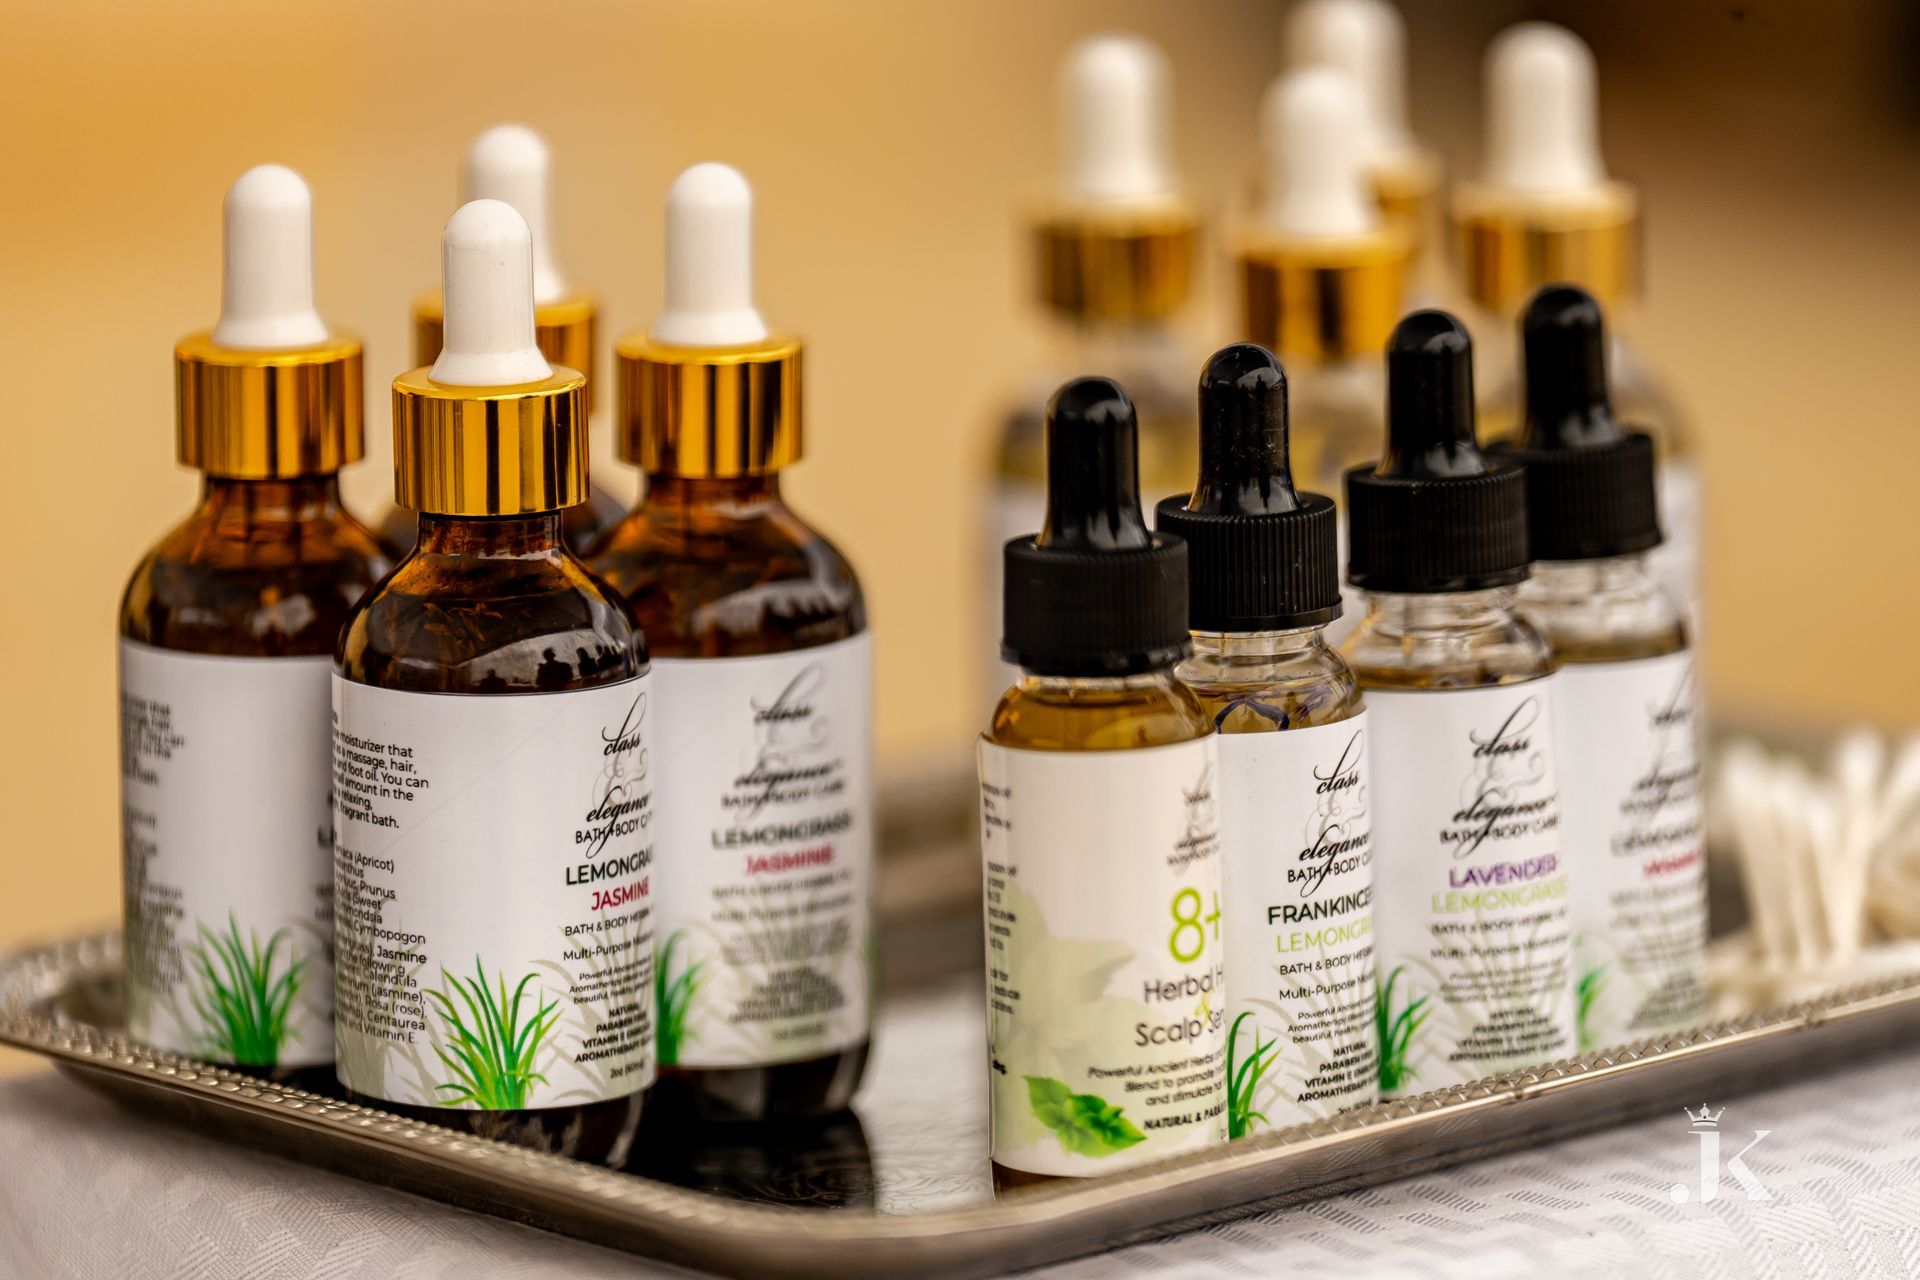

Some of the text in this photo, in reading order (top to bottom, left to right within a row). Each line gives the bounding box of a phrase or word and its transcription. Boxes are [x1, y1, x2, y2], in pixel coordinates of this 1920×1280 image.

[602, 691, 646, 756] class
[340, 731, 413, 758] moisturizer that
[347, 749, 388, 770] massage,
[390, 758, 417, 775] hair,
[1314, 729, 1363, 795] class
[348, 762, 363, 778] foot
[365, 769, 379, 782] oil.
[381, 772, 402, 786] You
[405, 776, 429, 788] can
[341, 789, 373, 811] relaxing,
[345, 776, 377, 796] amount
[380, 785, 390, 798] in
[393, 788, 414, 801] the
[340, 801, 400, 829] fragrant bath.
[575, 826, 607, 844] BATH
[615, 817, 641, 837] BODY
[354, 849, 395, 875] (Apricot)
[566, 844, 652, 886] LEMONGRA
[745, 842, 836, 876] JASMINE
[1287, 866, 1323, 883] BATH
[1334, 855, 1361, 876] BODY
[1449, 852, 1560, 889] LAVENDER
[359, 880, 396, 899] Prunus
[592, 876, 649, 911] JASMINE
[352, 892, 382, 911] (Sweet
[1268, 883, 1373, 926] FRANKINCE
[353, 919, 426, 945] Cymbopogon
[565, 923, 594, 937] BATH
[596, 921, 603, 932] &
[604, 915, 629, 930] BODY
[1168, 885, 1222, 965] 8+
[376, 945, 427, 964] Jasmine
[563, 941, 632, 961] Multi-Purpose
[360, 954, 406, 977] following
[579, 966, 613, 981] Powerful
[1280, 962, 1313, 976] BATH
[1315, 960, 1323, 971] &
[1325, 953, 1352, 970] BODY
[363, 967, 417, 988] Calendula
[371, 983, 426, 1005] (jasmine),
[1279, 979, 1356, 1000] Multi-Purpose
[365, 994, 389, 1012] Rosa
[392, 1001, 428, 1020] (rose),
[1298, 1006, 1336, 1021] Powerful
[367, 1009, 426, 1031] Centaurea
[1135, 1015, 1202, 1047] Scalp
[364, 1023, 405, 1042] Vitamin
[582, 1033, 619, 1048] VITAMIN
[1319, 1056, 1360, 1073] PARABEN
[1304, 1073, 1345, 1088] VITAMIN
[1145, 1094, 1171, 1106] and
[1143, 1112, 1193, 1130] NATURAL
